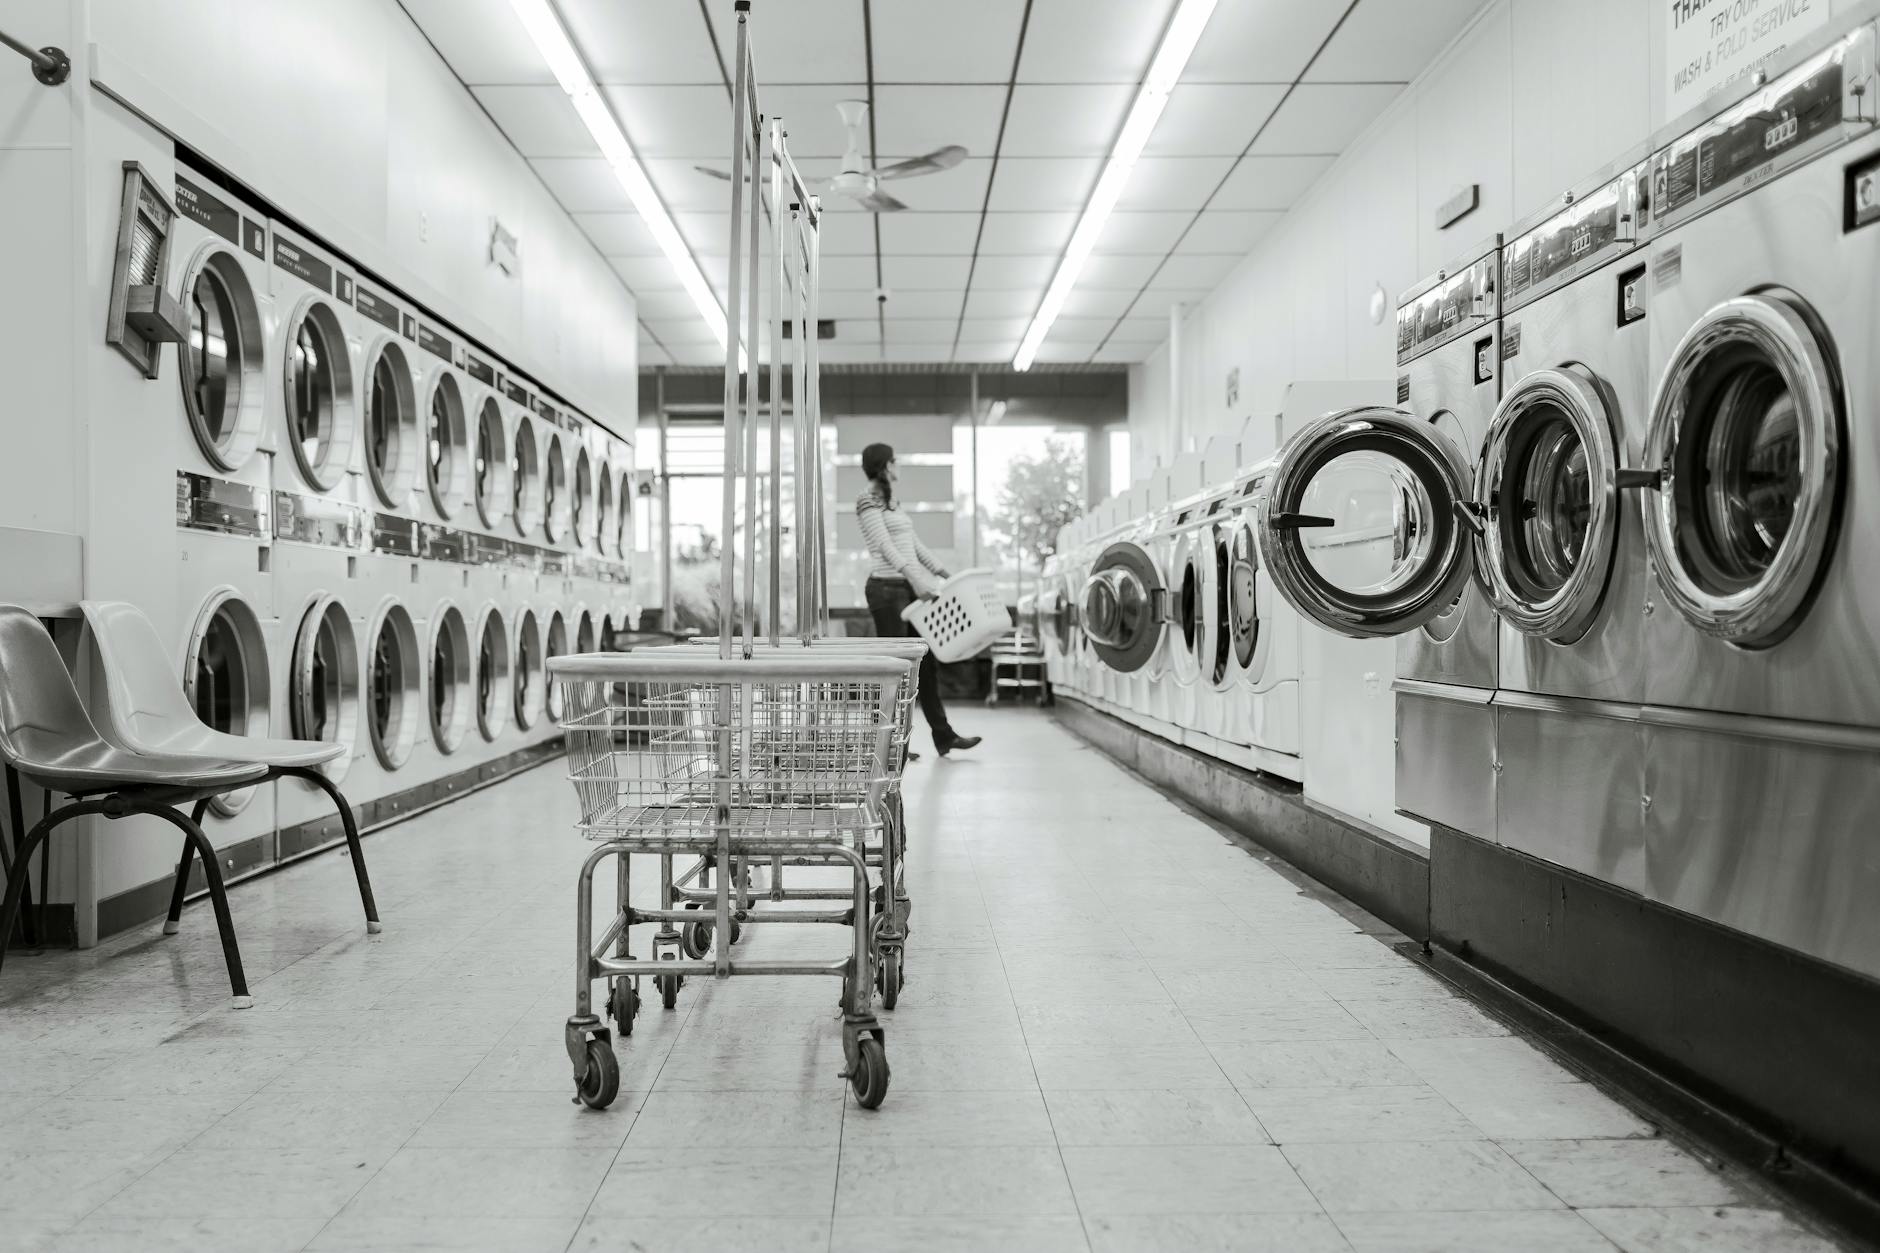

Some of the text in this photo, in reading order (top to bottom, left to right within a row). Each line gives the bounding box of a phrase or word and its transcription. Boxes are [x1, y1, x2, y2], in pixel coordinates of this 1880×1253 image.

[1711, 5, 1732, 39] TRY
[1674, 55, 1702, 94] WASH
[1704, 50, 1713, 73] &
[1716, 26, 1747, 66] FOLD
